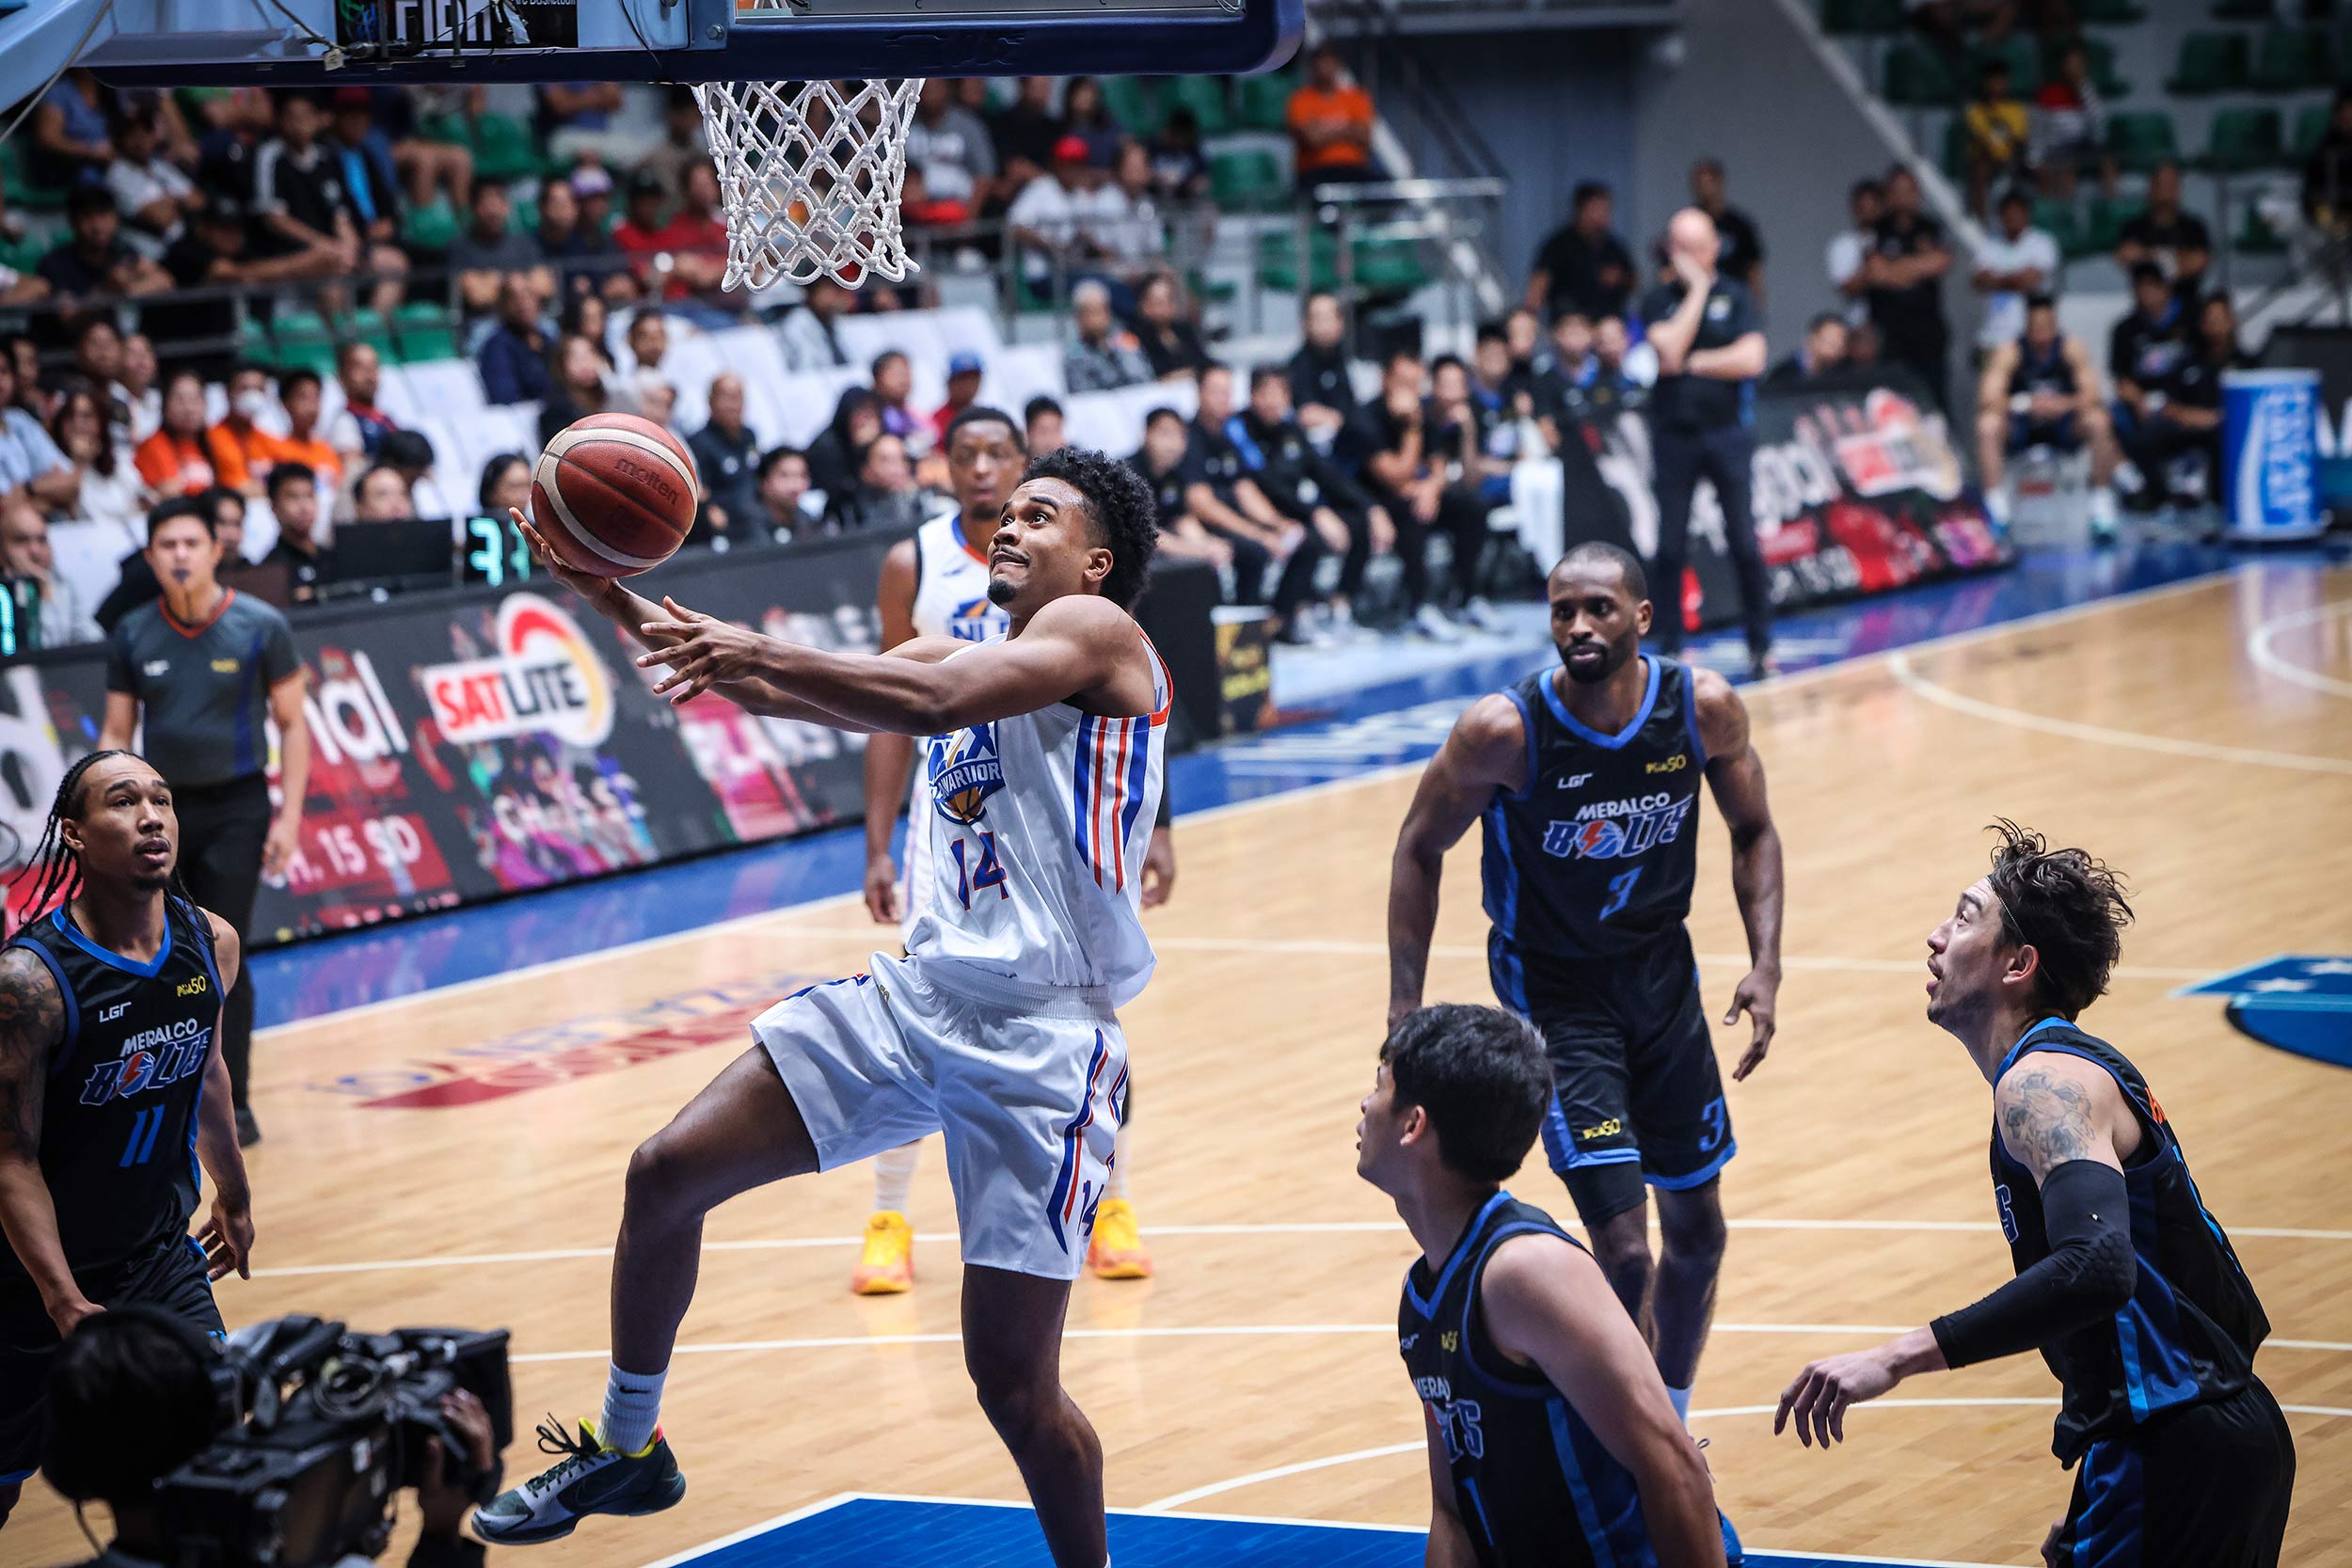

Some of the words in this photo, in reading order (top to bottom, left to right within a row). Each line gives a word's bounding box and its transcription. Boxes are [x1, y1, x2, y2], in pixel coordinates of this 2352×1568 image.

[615, 458, 678, 506] molten
[437, 663, 587, 732] SATLITE
[1576, 792, 1671, 821] MERALCO
[950, 831, 1009, 911] 14
[119, 1018, 199, 1058] MERALCO
[119, 1103, 167, 1167] 11
[1698, 1095, 1725, 1152] 3
[1075, 1180, 1105, 1238] 14
